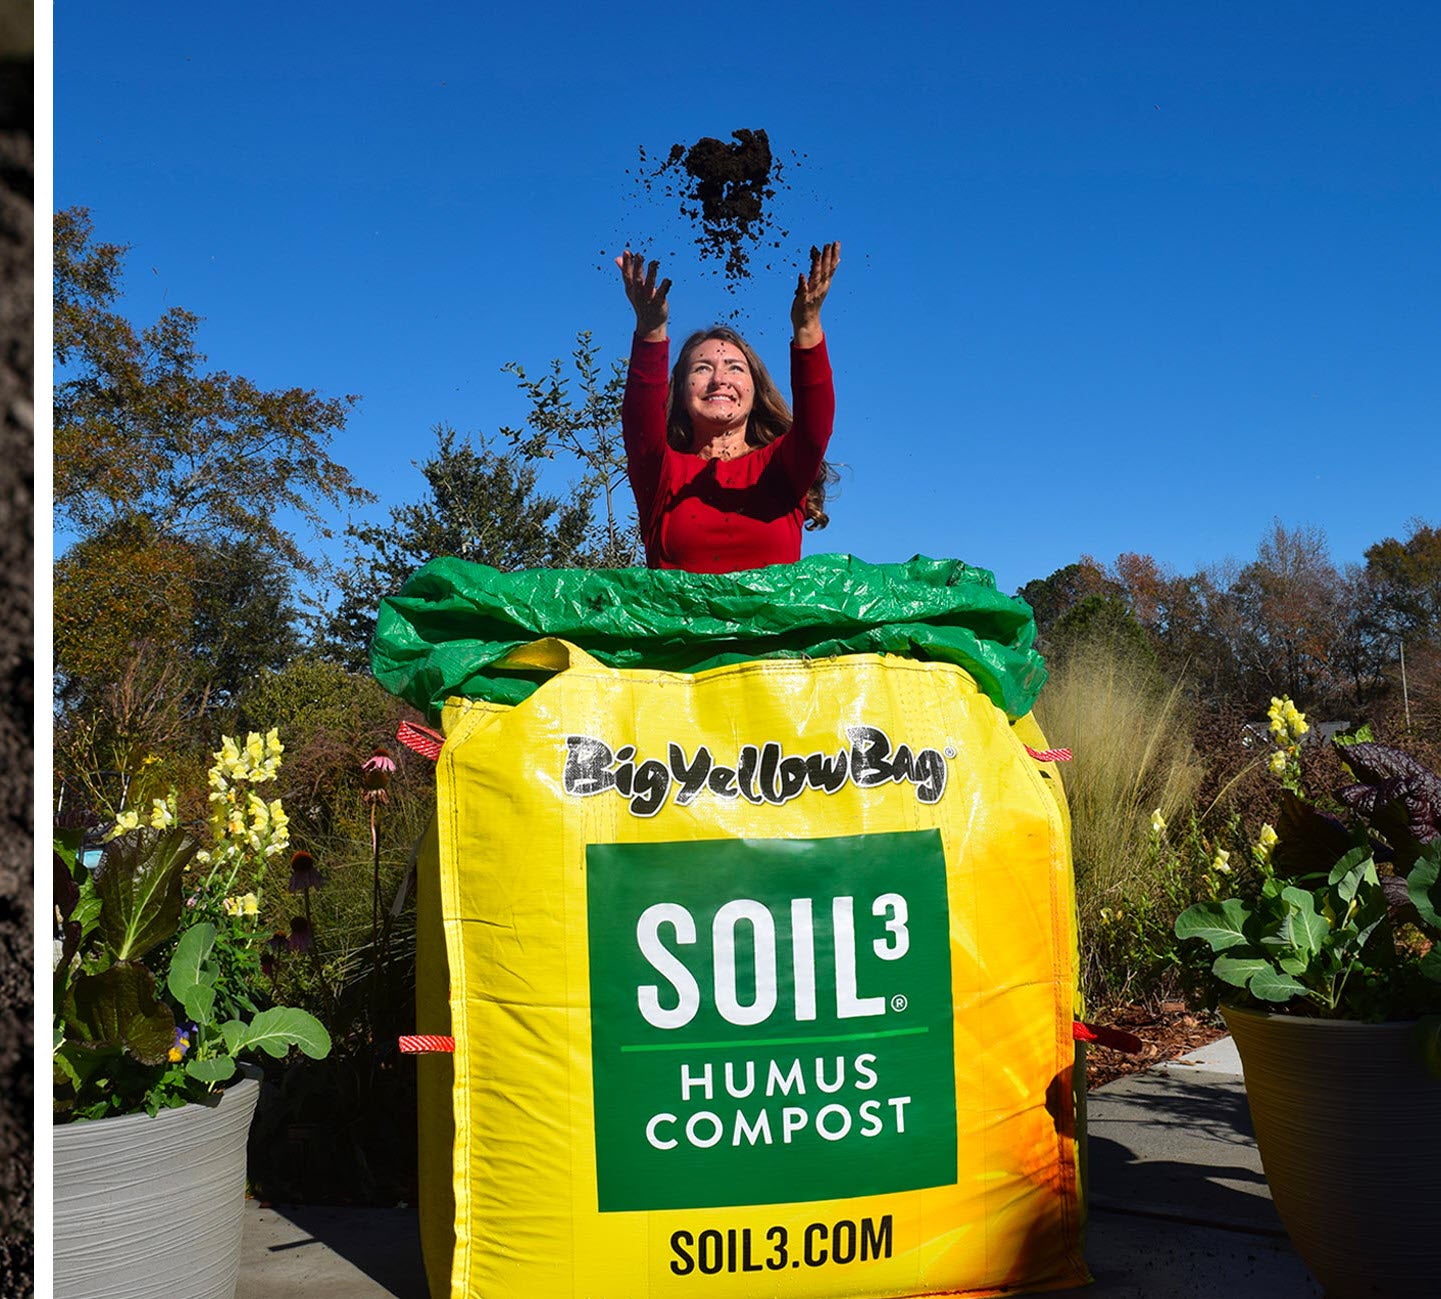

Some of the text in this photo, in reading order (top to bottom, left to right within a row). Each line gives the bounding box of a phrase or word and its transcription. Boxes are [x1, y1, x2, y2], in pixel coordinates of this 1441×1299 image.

[681, 1053, 879, 1100] HUMUS
[645, 1097, 912, 1150] COMPOST
[670, 1214, 893, 1275] SOIL3.COM
